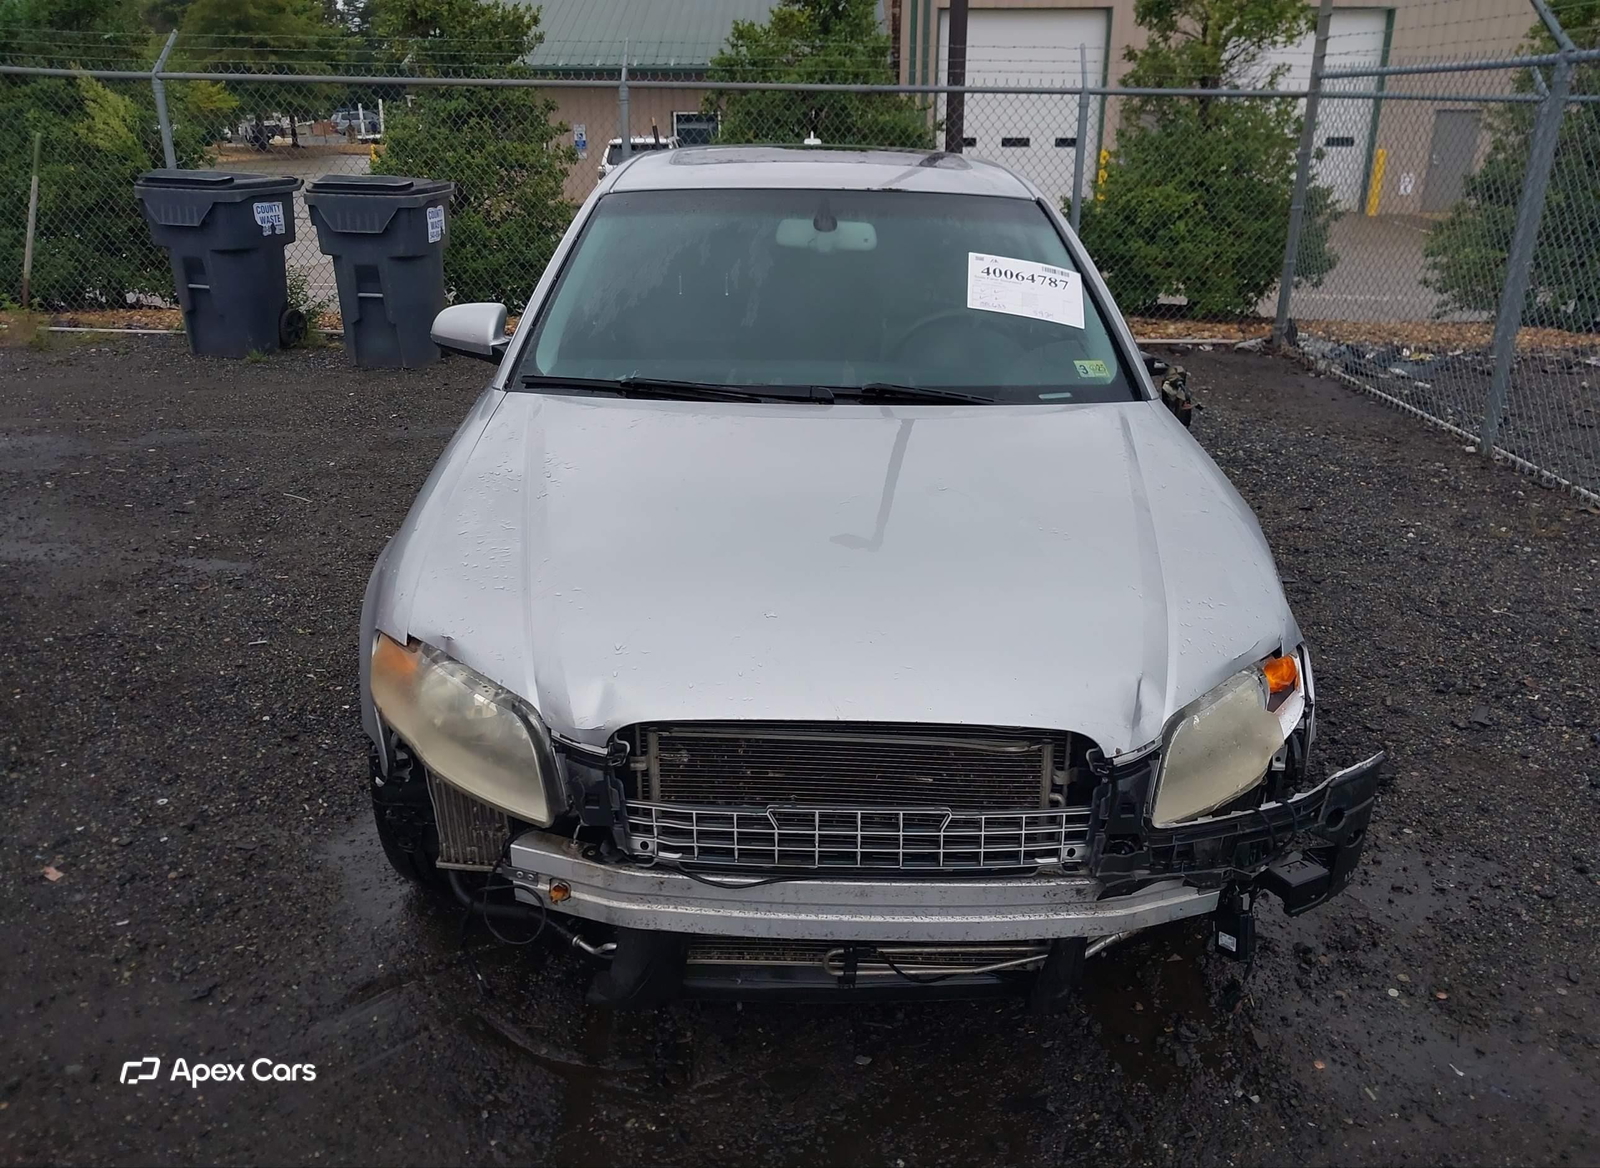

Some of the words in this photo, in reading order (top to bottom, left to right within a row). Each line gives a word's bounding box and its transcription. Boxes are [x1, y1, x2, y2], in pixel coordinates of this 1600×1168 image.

[255, 204, 280, 215] COUNTY
[259, 214, 281, 225] WASTE
[981, 266, 1069, 290] 40064787
[1079, 364, 1089, 375] 3
